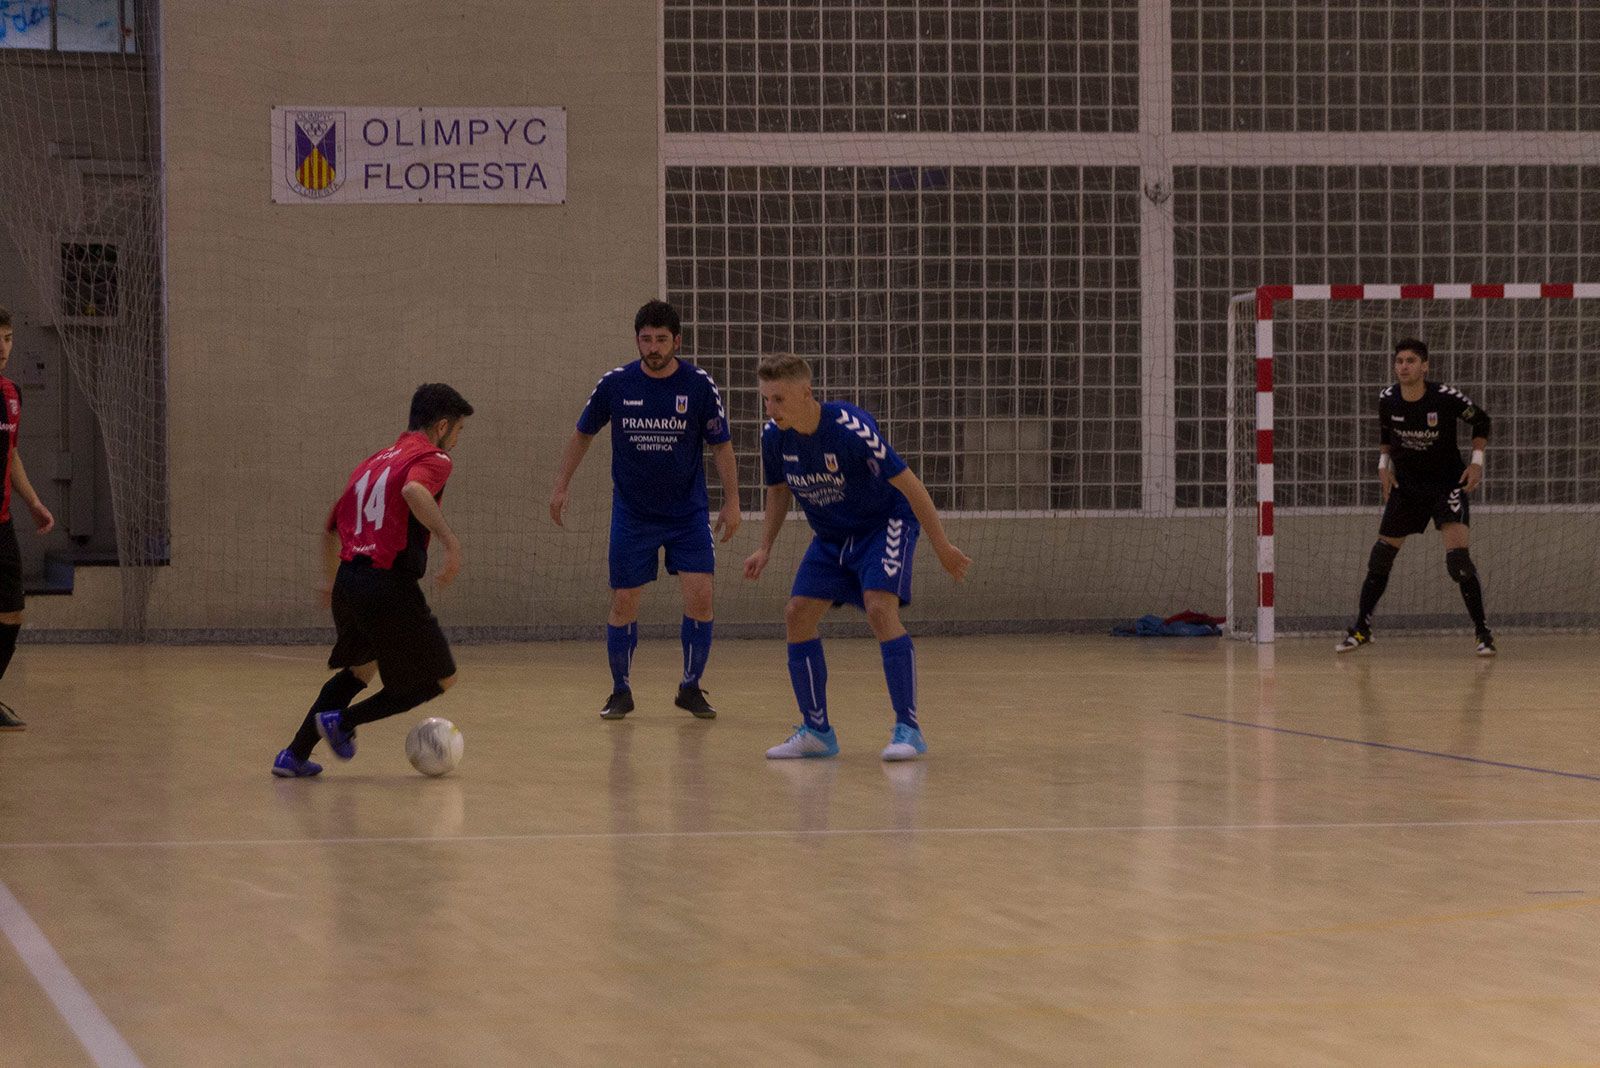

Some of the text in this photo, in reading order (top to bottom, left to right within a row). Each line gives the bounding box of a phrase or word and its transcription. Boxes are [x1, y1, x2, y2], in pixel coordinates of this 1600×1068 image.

[363, 118, 547, 147] OLIMPYC
[364, 162, 547, 190] FLORESTA
[354, 466, 391, 536] 14
